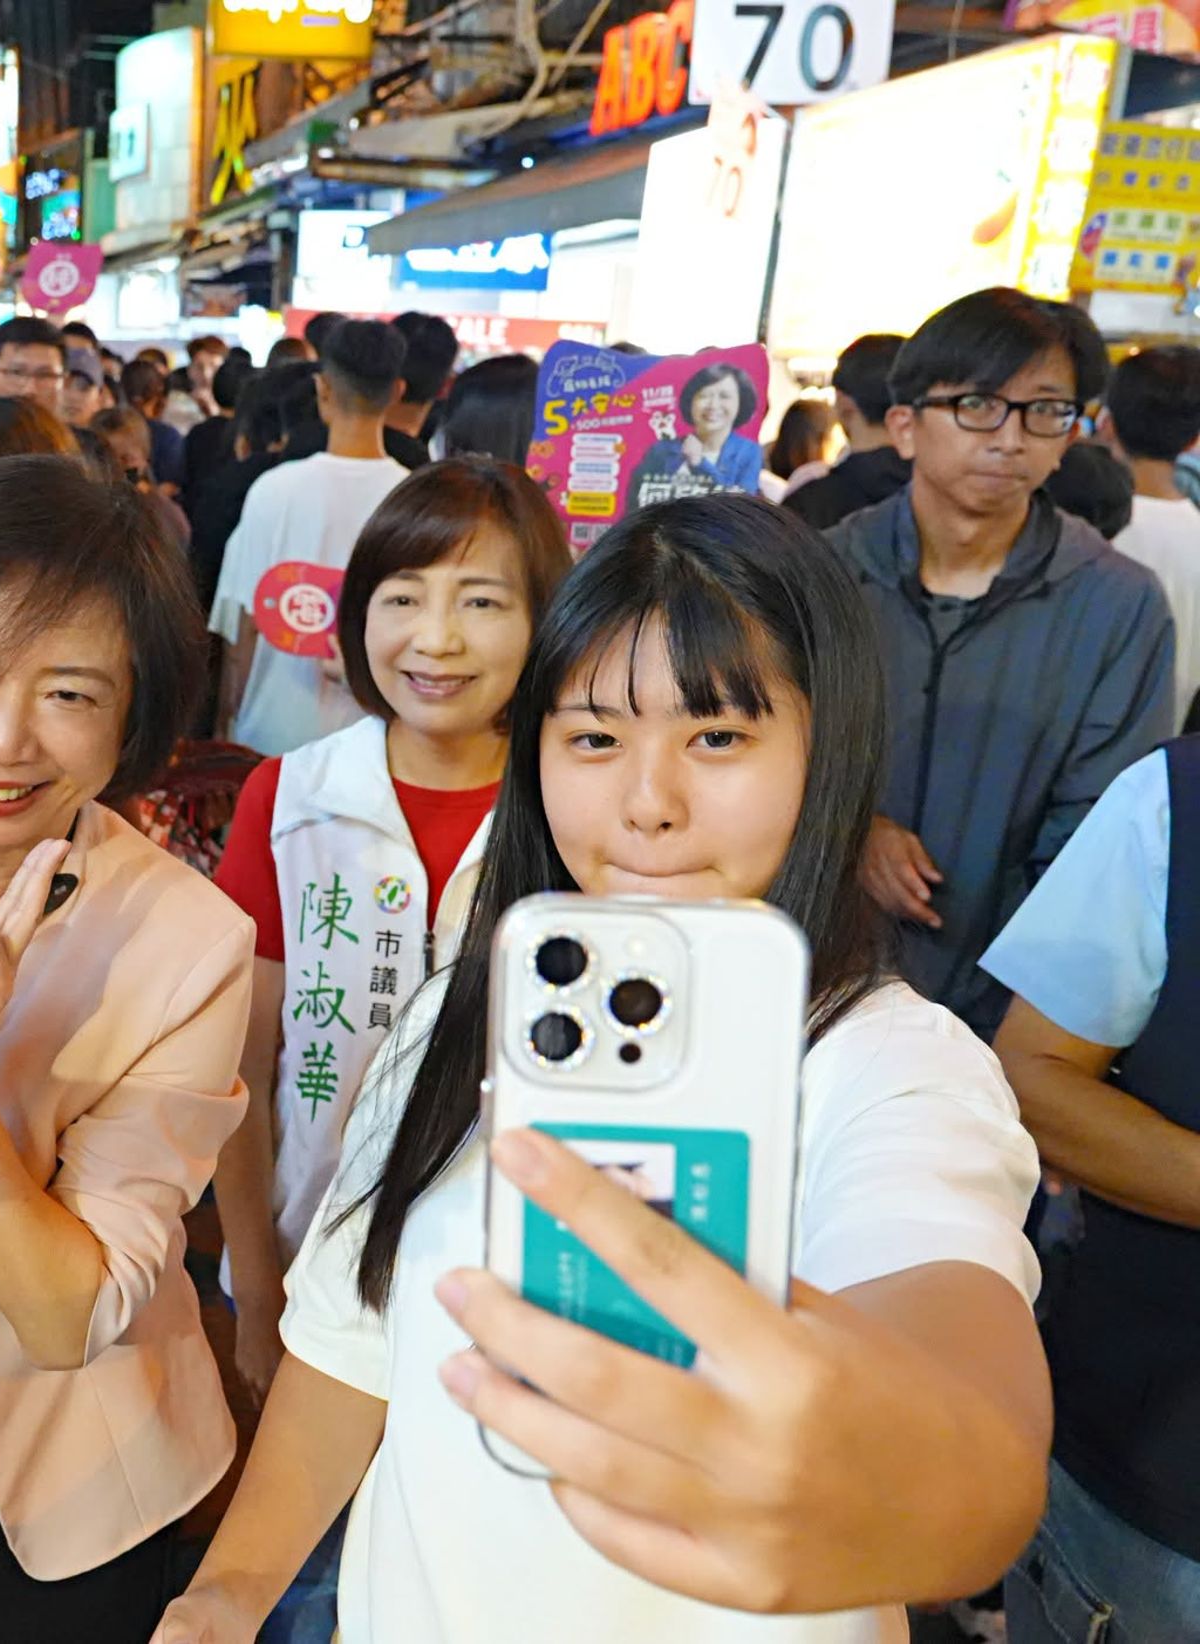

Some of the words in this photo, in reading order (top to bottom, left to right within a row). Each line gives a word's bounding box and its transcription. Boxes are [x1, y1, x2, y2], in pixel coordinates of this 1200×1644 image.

[590, 0, 695, 136] ABC
[734, 4, 854, 92] 70
[293, 872, 359, 1123] 陳淑華
[366, 929, 403, 1030] 市議員
